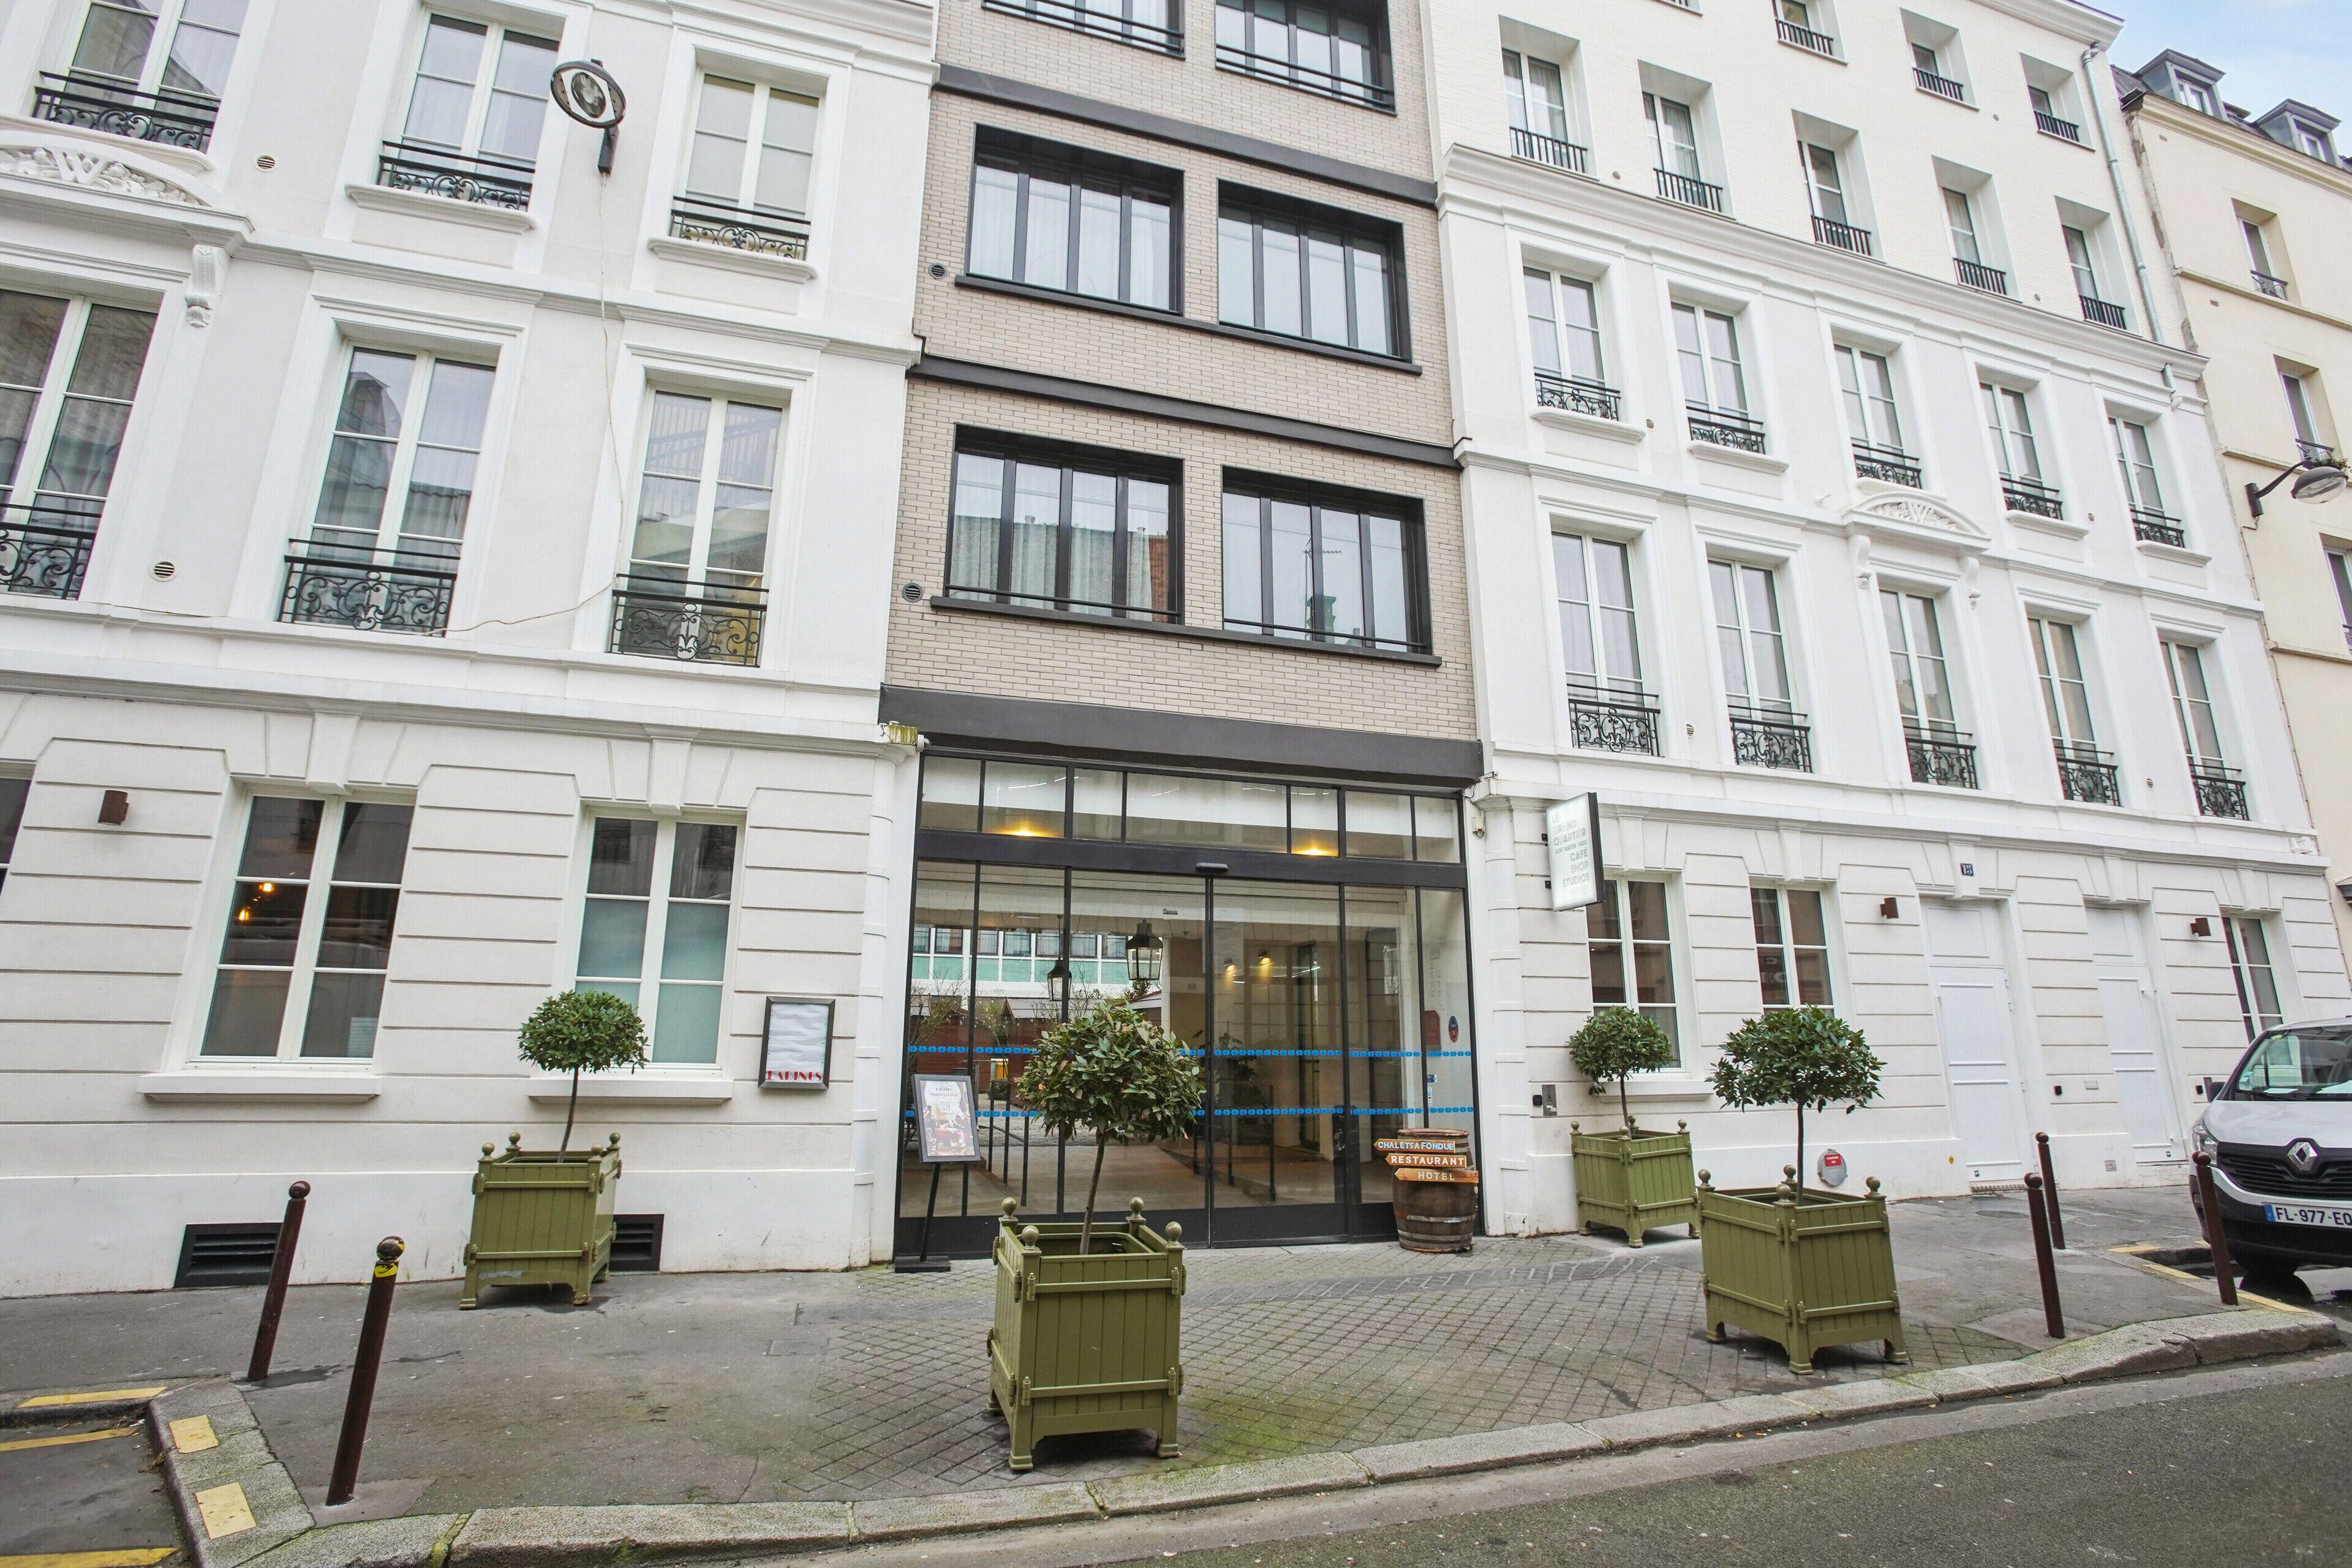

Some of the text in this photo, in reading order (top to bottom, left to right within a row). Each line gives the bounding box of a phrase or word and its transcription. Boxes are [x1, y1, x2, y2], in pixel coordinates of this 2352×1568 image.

[1553, 827, 1586, 846] QUARTIER
[1570, 860, 1589, 873] SHOP
[1962, 864, 1972, 875] 15
[1562, 872, 1590, 888] STUDIOS
[1378, 1140, 1414, 1150] CHALETS
[1420, 1142, 1454, 1151] FONDUE
[1391, 1155, 1464, 1166] RESTAURANT
[1417, 1170, 1456, 1182] HOTEL
